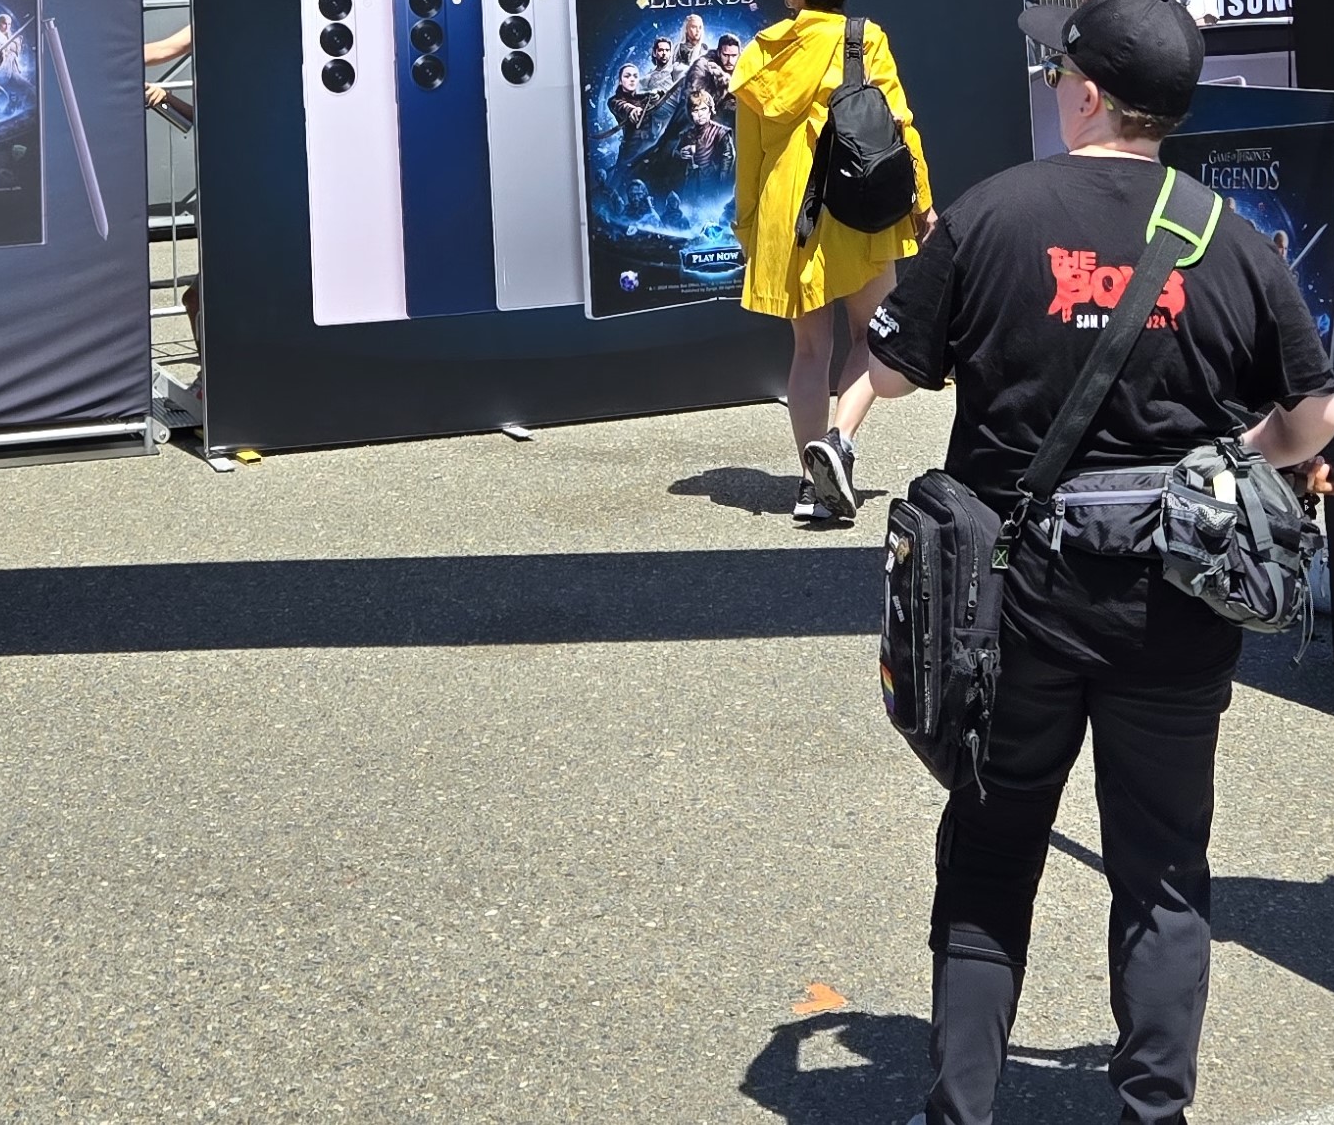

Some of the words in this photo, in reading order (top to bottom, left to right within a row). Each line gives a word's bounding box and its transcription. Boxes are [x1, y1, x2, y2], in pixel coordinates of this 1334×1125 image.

[1201, 160, 1280, 191] LEGENDS
[692, 253, 715, 264] PLAY
[716, 251, 739, 262] NOW
[1047, 246, 1097, 271] THE
[1051, 265, 1186, 315] BOS
[1076, 314, 1098, 329] SAN
